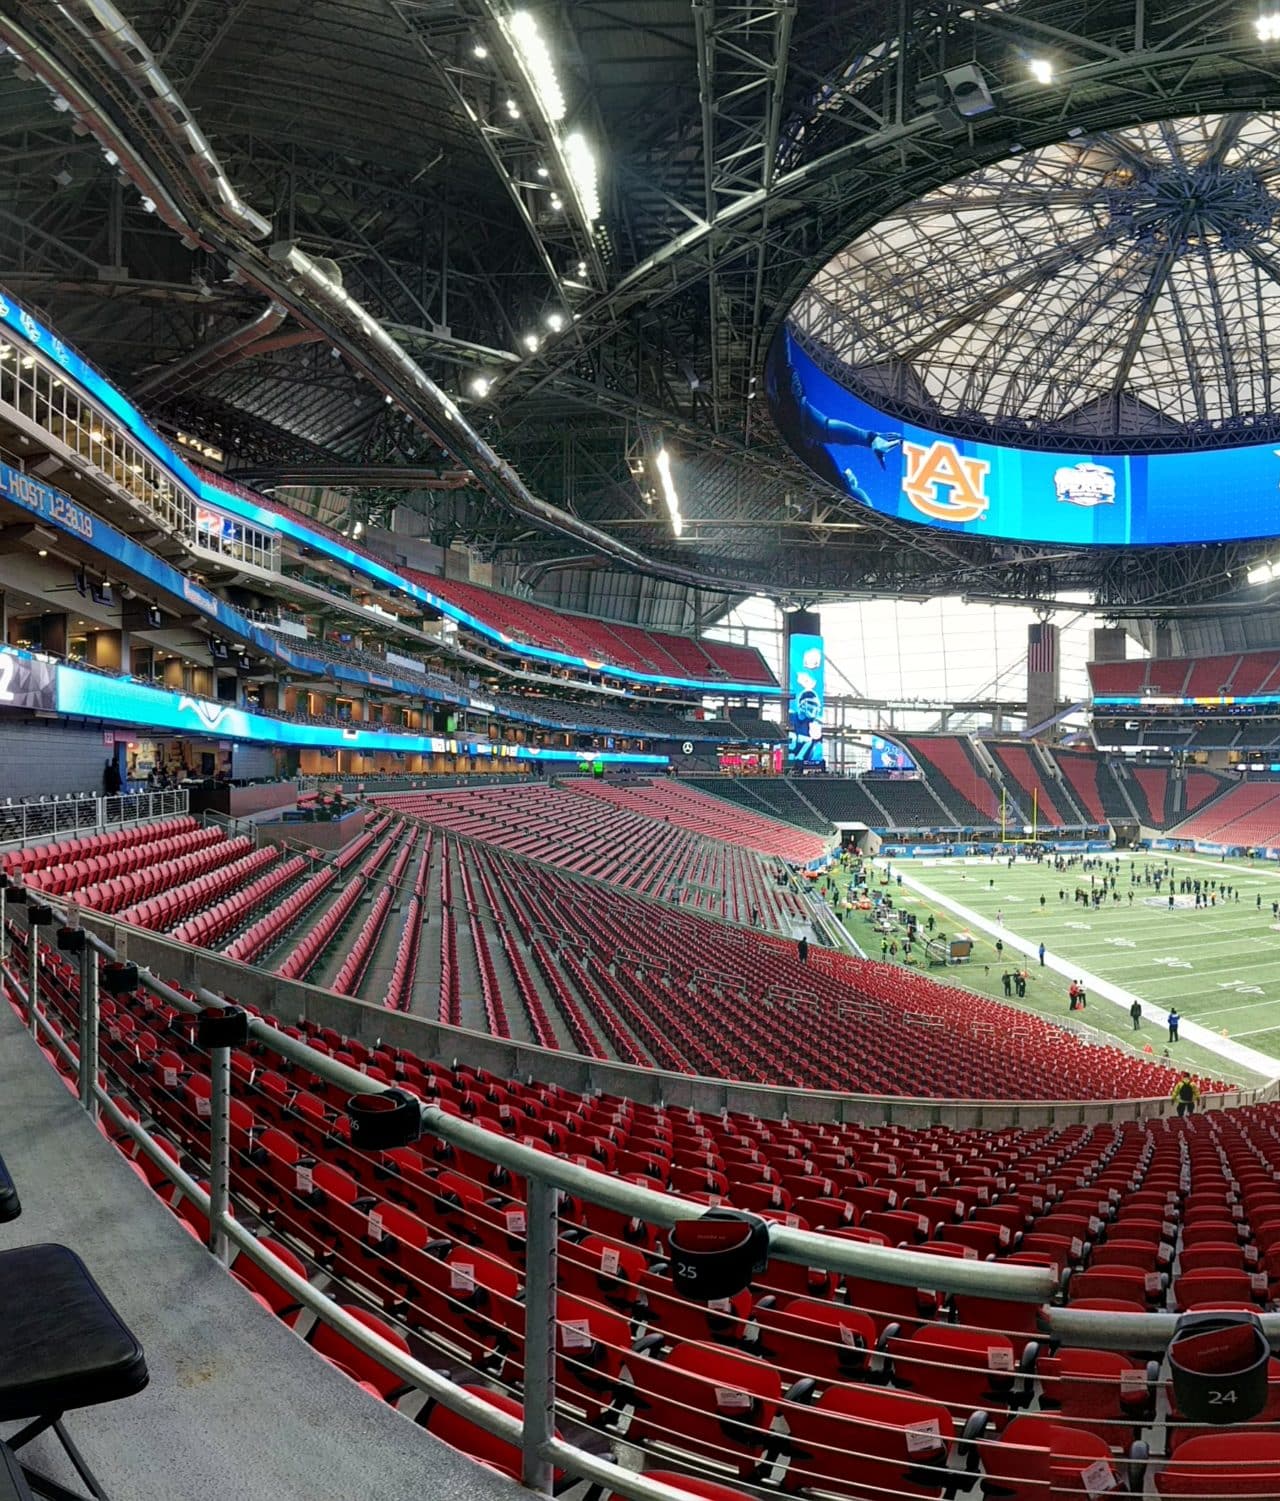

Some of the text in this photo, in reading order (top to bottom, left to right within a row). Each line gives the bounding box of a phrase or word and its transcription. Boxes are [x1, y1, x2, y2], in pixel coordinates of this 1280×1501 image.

[8, 470, 46, 511] HOST
[1217, 979, 1261, 994] 10
[677, 1262, 697, 1279] 25
[1207, 1390, 1238, 1404] 24
